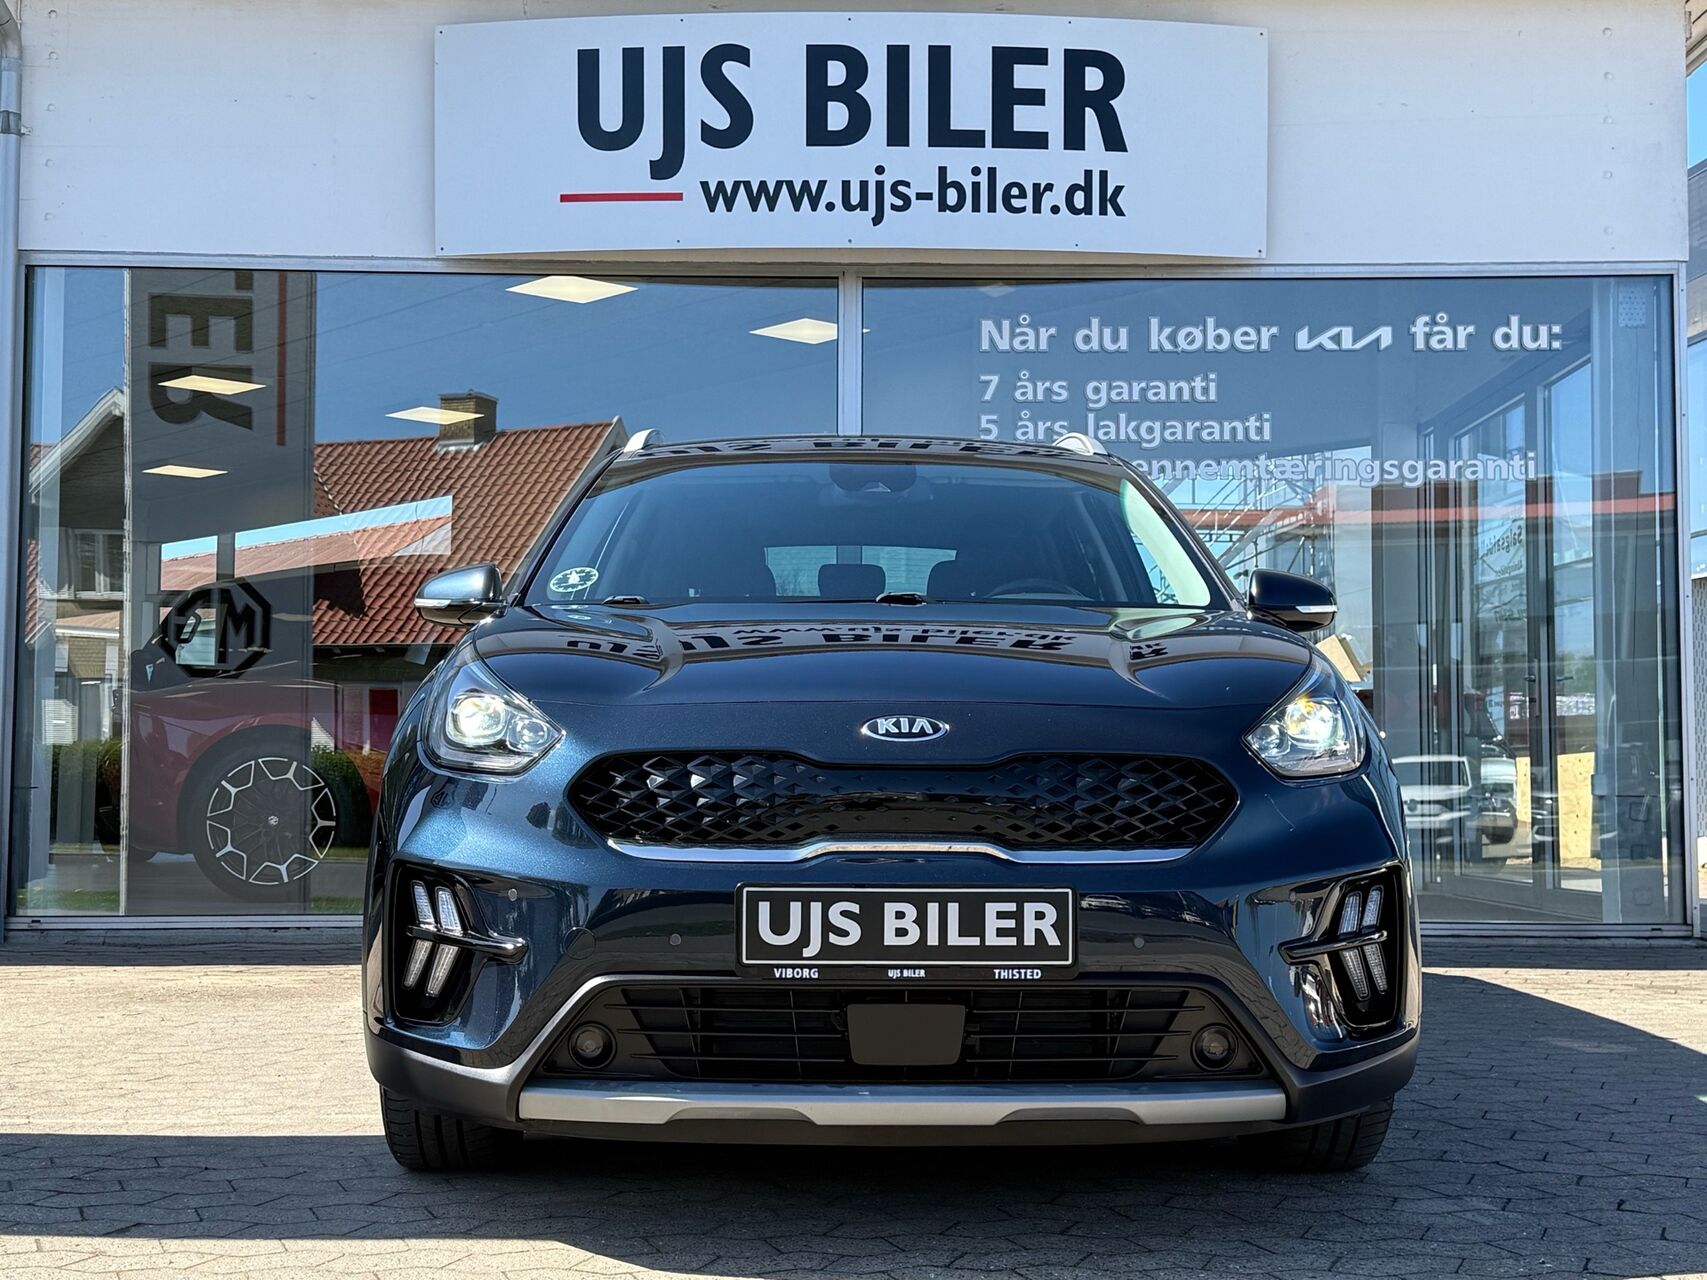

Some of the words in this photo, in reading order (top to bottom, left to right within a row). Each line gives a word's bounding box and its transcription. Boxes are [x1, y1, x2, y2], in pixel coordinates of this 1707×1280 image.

[576, 43, 754, 181] UJS
[805, 44, 1129, 153] BILER
[699, 164, 1127, 227] www.ujs-biler.dk
[979, 314, 1056, 352] Når
[1073, 316, 1129, 352] du
[1148, 315, 1279, 353] køber
[1410, 312, 1475, 351] får
[1493, 314, 1563, 350] du:
[979, 374, 1000, 402] 7
[1013, 369, 1069, 402] års
[1084, 372, 1218, 410] garanti
[979, 414, 999, 442] 5
[1014, 410, 1069, 441] års
[1087, 411, 1273, 447] lakgaranti
[1131, 451, 1538, 489] ennemtæringsgaranti
[876, 717, 934, 735] KIA
[758, 901, 862, 957] UJS
[883, 902, 1062, 946] BILER
[773, 967, 819, 979] VIBORG
[888, 969, 901, 978] UJS
[903, 969, 926, 977] BILER
[993, 968, 1042, 980] THISTED
